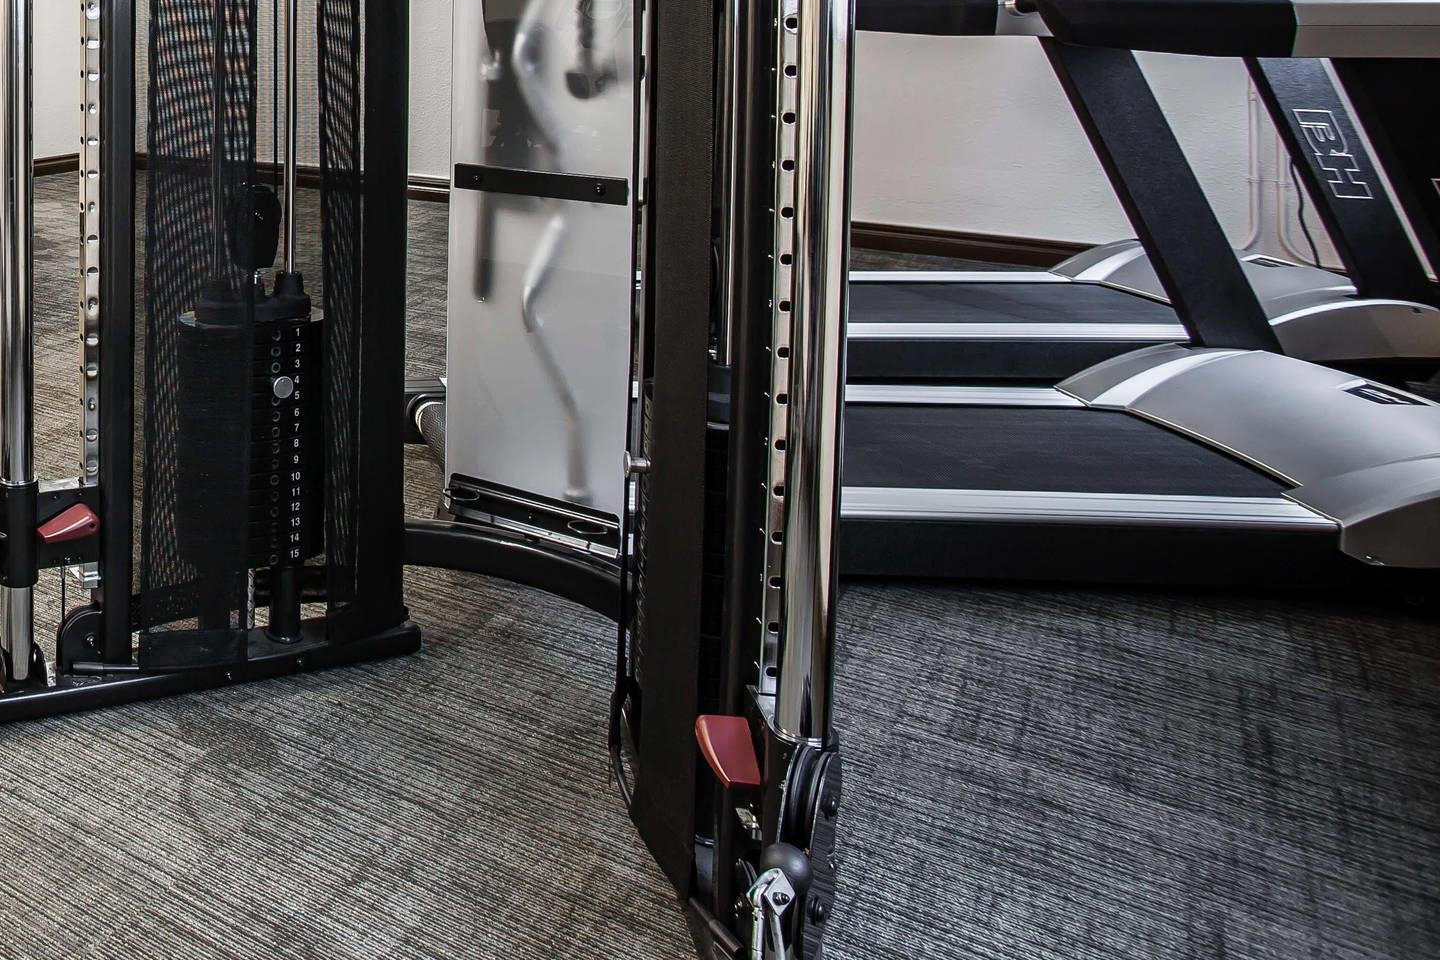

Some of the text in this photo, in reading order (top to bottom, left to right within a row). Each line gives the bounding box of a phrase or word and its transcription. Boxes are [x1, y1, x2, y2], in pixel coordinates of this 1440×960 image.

[1292, 108, 1374, 200] BH
[296, 328, 300, 337] 1
[295, 344, 301, 352] 2
[294, 359, 301, 368] 3
[294, 375, 300, 384] 4
[294, 391, 300, 400] 5
[294, 408, 300, 417] 6
[294, 423, 300, 432] 7
[293, 438, 300, 447] 8
[293, 455, 299, 464] 9
[291, 472, 301, 481] 10
[291, 487, 301, 496] 11
[291, 502, 301, 511] 12
[291, 517, 301, 527] 13
[290, 533, 300, 543] 14
[290, 549, 300, 559] 15
